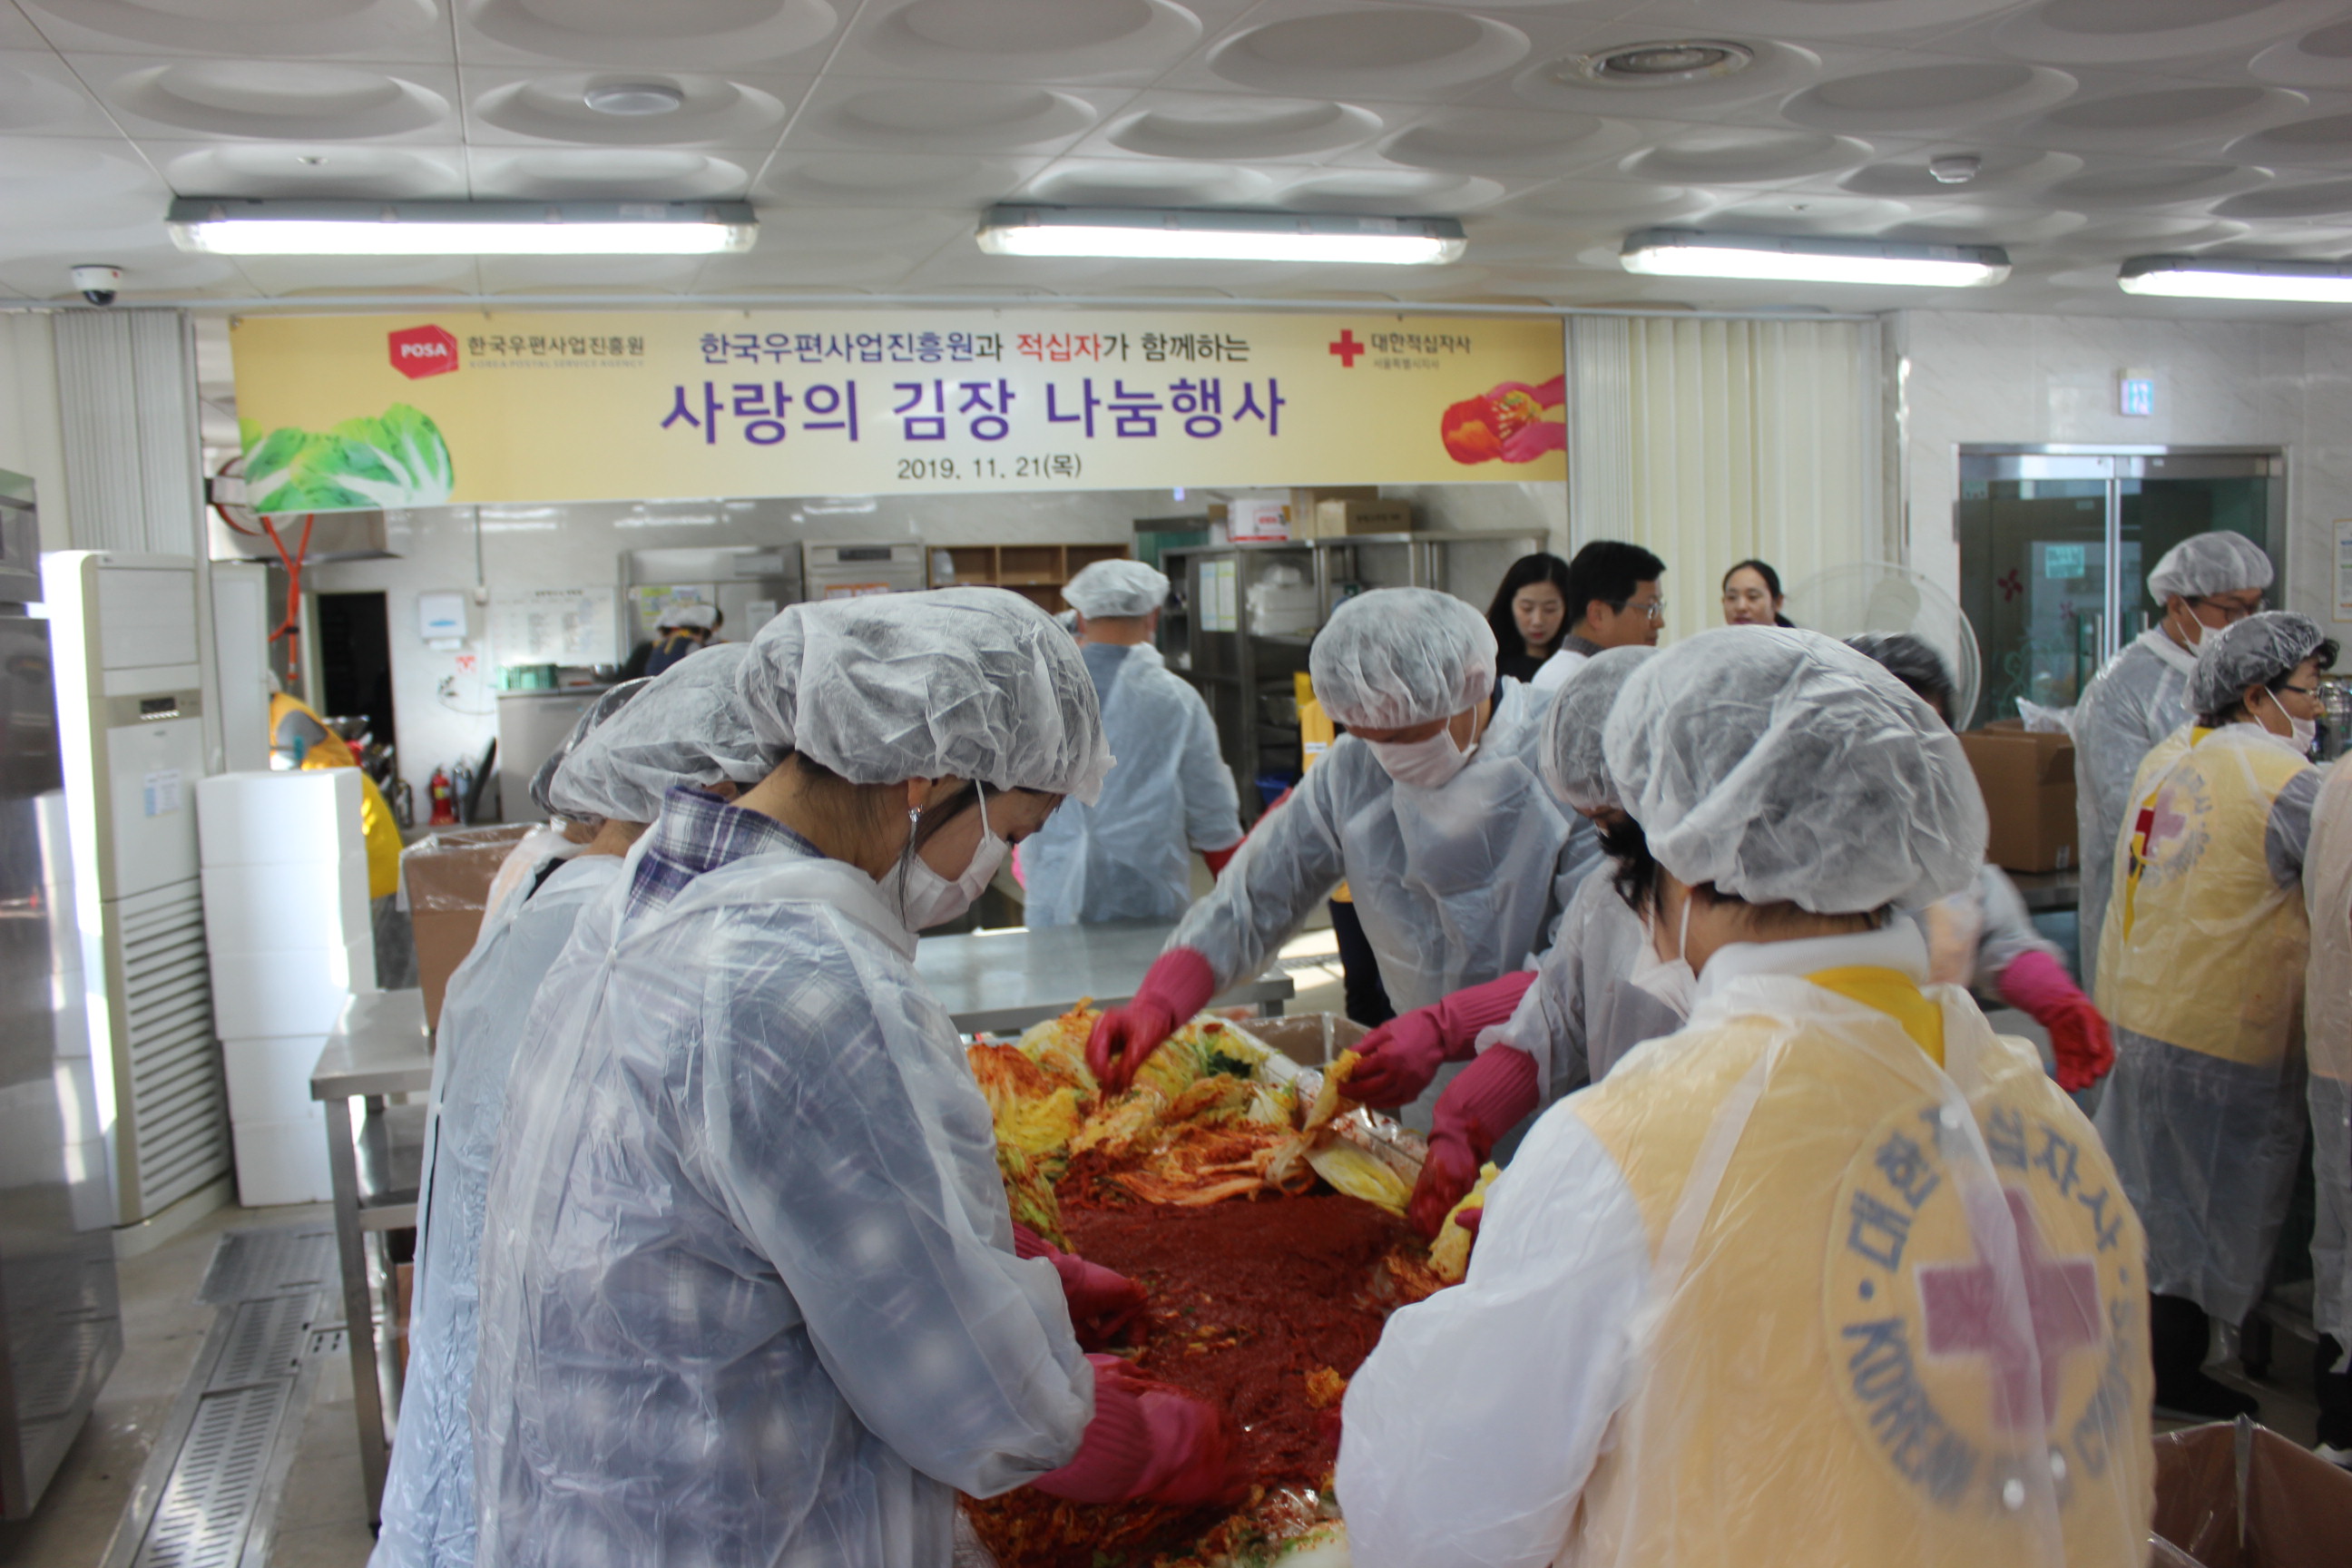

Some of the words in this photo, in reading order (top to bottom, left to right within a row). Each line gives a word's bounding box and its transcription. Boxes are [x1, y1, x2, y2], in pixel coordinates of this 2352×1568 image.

[400, 343, 448, 358] POSA
[467, 336, 644, 357] 한국우편사업진흥원
[700, 331, 1004, 365] 한국우편사업진흥원과
[1016, 332, 1130, 363] 적십자가
[1141, 332, 1250, 362] 함께하는
[1371, 332, 1471, 355] 대한적십자사
[660, 379, 859, 446] 사랑의
[892, 377, 1016, 443] 김장
[1045, 377, 1287, 440] 나눔행사
[897, 457, 962, 480] 2019.
[972, 457, 1006, 479] 11.
[1015, 453, 1083, 479] 21(목)
